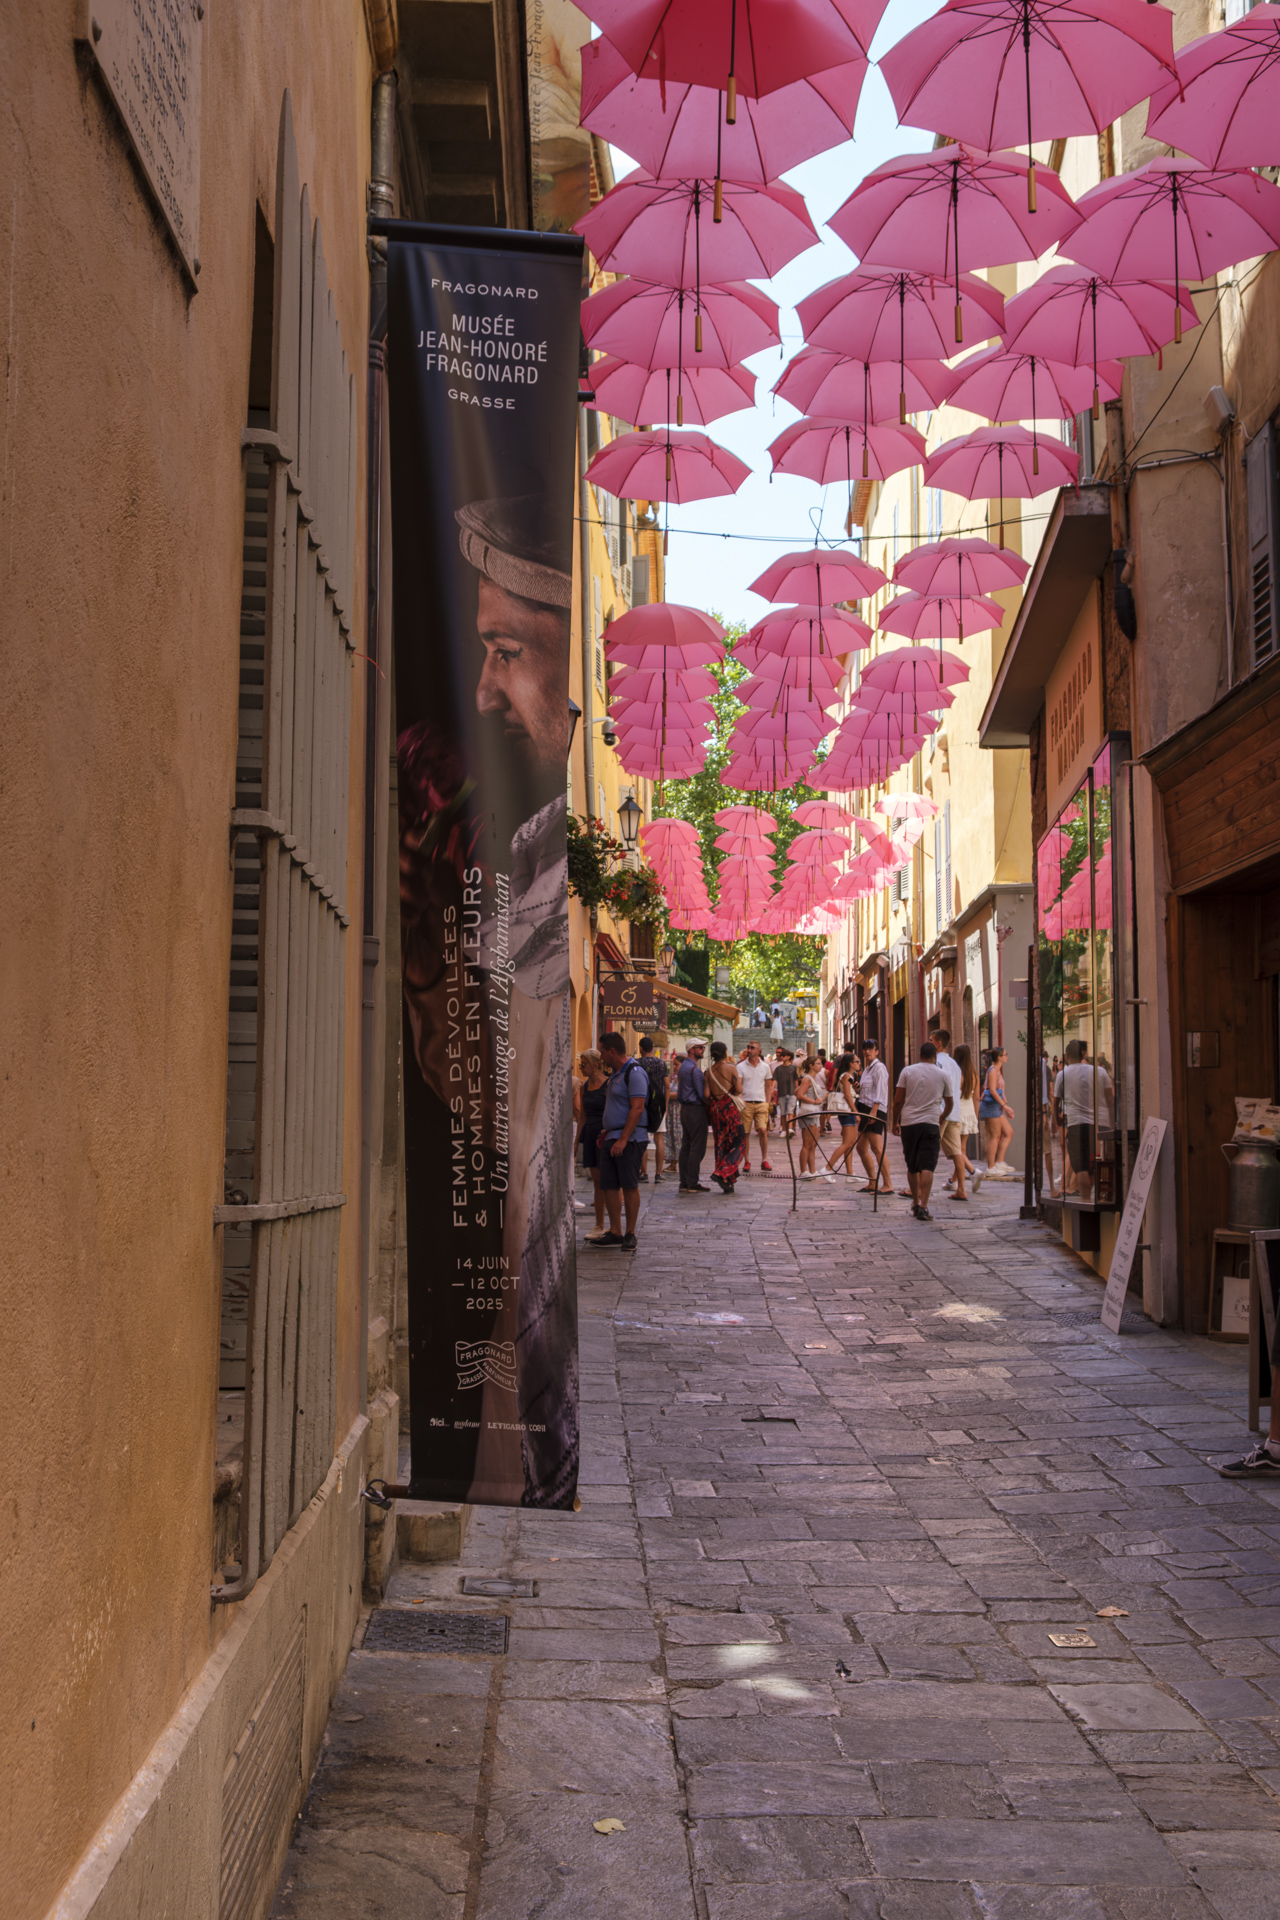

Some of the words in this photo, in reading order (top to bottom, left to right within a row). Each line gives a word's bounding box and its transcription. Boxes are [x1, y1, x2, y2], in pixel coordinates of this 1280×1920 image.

[431, 278, 538, 299] FRAGONARD
[452, 314, 515, 336] MUSÉE
[417, 330, 548, 362] JEAN-HONORÉ
[426, 353, 538, 384] FRAGONARD
[447, 388, 516, 410] GRASSE
[1051, 641, 1092, 752] FRAGONARD
[1057, 702, 1085, 786] MAISON
[463, 866, 483, 987] FLEURS
[489, 872, 516, 1003] l'Afghanistan
[443, 904, 463, 1082] DÉVOILÉES
[465, 1001, 480, 1041] EN
[489, 1008, 509, 1030] de
[603, 1005, 653, 1016] FLORIAN
[489, 1047, 516, 1100] visage
[467, 1054, 486, 1195] HOMMES
[492, 1102, 509, 1156] autre
[451, 1095, 468, 1227] FEMMES
[490, 1161, 509, 1192] Un
[475, 1207, 487, 1228] &
[456, 1257, 473, 1270] 14
[477, 1256, 510, 1270] JUIN
[470, 1277, 485, 1290] 12
[490, 1276, 520, 1291] OCT
[466, 1298, 504, 1310] 2025
[460, 1346, 512, 1364] FRAGONARD
[462, 1371, 484, 1385] GRASSE
[498, 1422, 527, 1431] FIGARO
